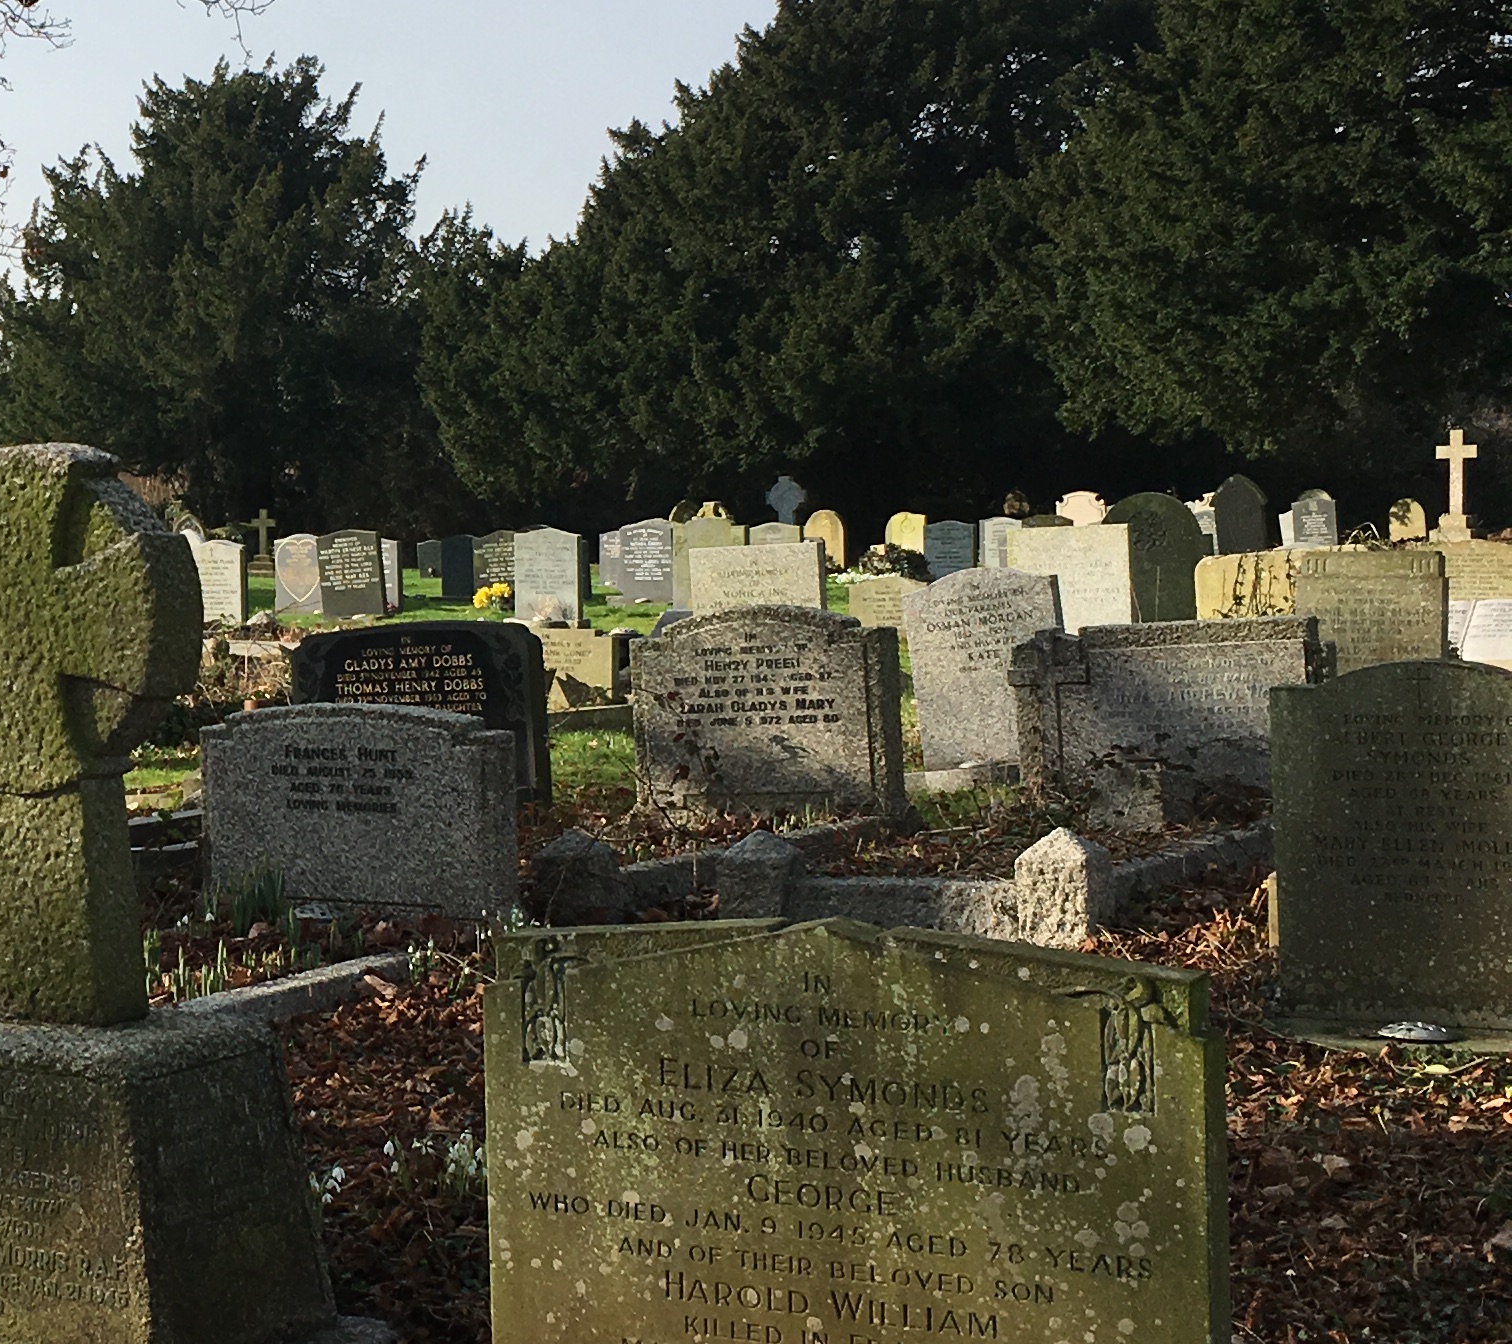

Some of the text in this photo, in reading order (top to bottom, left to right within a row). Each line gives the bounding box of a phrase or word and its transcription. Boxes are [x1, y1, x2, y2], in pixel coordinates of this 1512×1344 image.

[978, 610, 1033, 626] MORGAN
[361, 644, 453, 657] LOVING MEMORY OF
[694, 647, 732, 657] LOVING
[344, 654, 473, 672] GLADYS AMY DOBBS
[704, 657, 800, 672] HENRY PREEN
[371, 669, 418, 680] NOVEMBER
[443, 668, 467, 677] AGED
[335, 677, 484, 696] THOMAS HENRY DOBBS
[698, 686, 729, 698] ALSO
[781, 684, 809, 695] WIFE
[374, 693, 421, 704] NOVEMBER
[446, 691, 470, 701] AGED
[730, 699, 788, 713] GLADYS
[794, 697, 836, 711] MARY
[709, 716, 738, 727] JUNE
[787, 713, 819, 725] AGED
[1418, 713, 1495, 726] MEMORY
[1422, 730, 1508, 748] GEORGE
[284, 745, 398, 762] FRANCES HUNT
[1367, 750, 1471, 767] SYMONDS
[271, 764, 299, 776] DIED
[306, 766, 350, 778] AUGUST
[1332, 768, 1375, 782] DIED
[352, 785, 392, 797] YEARS
[1349, 787, 1396, 801] AGED
[286, 798, 398, 814] LOVING MEMORIES
[804, 972, 832, 994] IN
[692, 998, 955, 1035] LOVING MEMORY
[801, 1038, 839, 1060] OF
[658, 1056, 990, 1114] ELIZA SYMONDS
[559, 1090, 621, 1116] DIED
[758, 1108, 829, 1136] 1940
[847, 1116, 934, 1144] AGED
[956, 1127, 982, 1149] 81
[1001, 1130, 1110, 1159] YEARS
[593, 1130, 1081, 1196] ALSO OF HER BELOVED HUSBAND
[746, 1173, 899, 1218] GEORGE
[528, 1190, 1155, 1281] WHO DIED JAN. 9 1945 AGED 78 YEARS
[618, 1236, 1055, 1305] AND OF THEIR BELOVED SON
[663, 1268, 999, 1341] HAROLD WILLIAM
